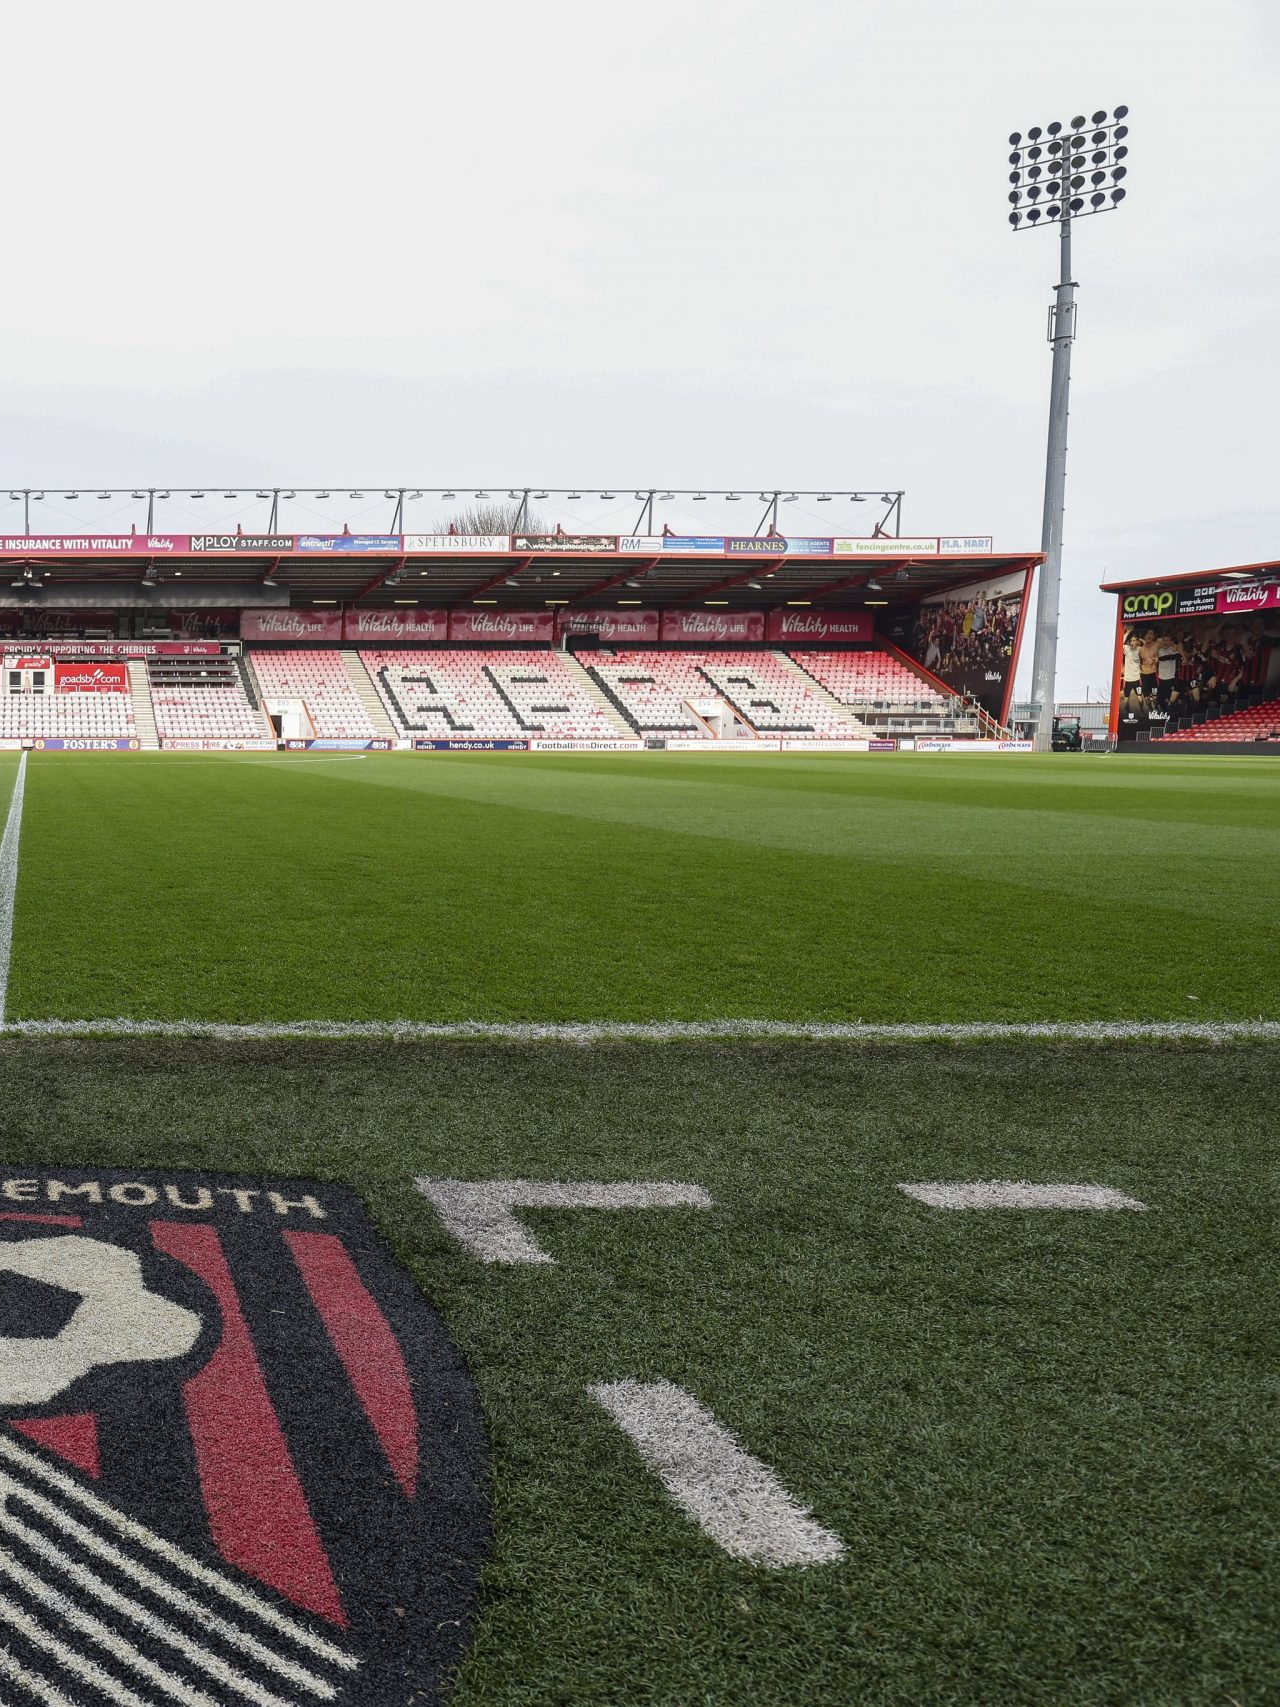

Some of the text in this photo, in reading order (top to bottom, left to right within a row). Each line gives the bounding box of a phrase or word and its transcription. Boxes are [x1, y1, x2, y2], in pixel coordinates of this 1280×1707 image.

[6, 540, 61, 550] INSURANCE
[63, 540, 88, 550] WITH
[91, 540, 133, 549] VITALITY
[147, 537, 173, 552] Vitality
[417, 537, 495, 548] SPETISBURY
[532, 543, 615, 551] www.dwphousing.co.uk
[621, 539, 640, 550] RM
[730, 541, 784, 550] HEARNES
[856, 542, 934, 552] fencingcentre.co.uk
[942, 540, 990, 548] M.A. HART
[1226, 587, 1268, 606] Vitality
[1124, 592, 1173, 615] cmp
[259, 614, 322, 637] Vitality LIFE
[358, 614, 435, 636] Vitality HEALTH
[470, 614, 534, 638] Vitality LIFE
[617, 624, 646, 632] HEALTH
[682, 614, 744, 638] Vitality LIFE
[782, 614, 858, 638] Vitality HEALTH
[4, 646, 40, 654] PROUDLY
[44, 646, 96, 654] SUPPORTING
[118, 646, 156, 654] CHERRIES
[1148, 710, 1170, 722] Vitality
[63, 740, 118, 750] FOSTER'S
[164, 740, 221, 750] EXPRESS HIRE
[449, 740, 494, 749] hendy.co.uk
